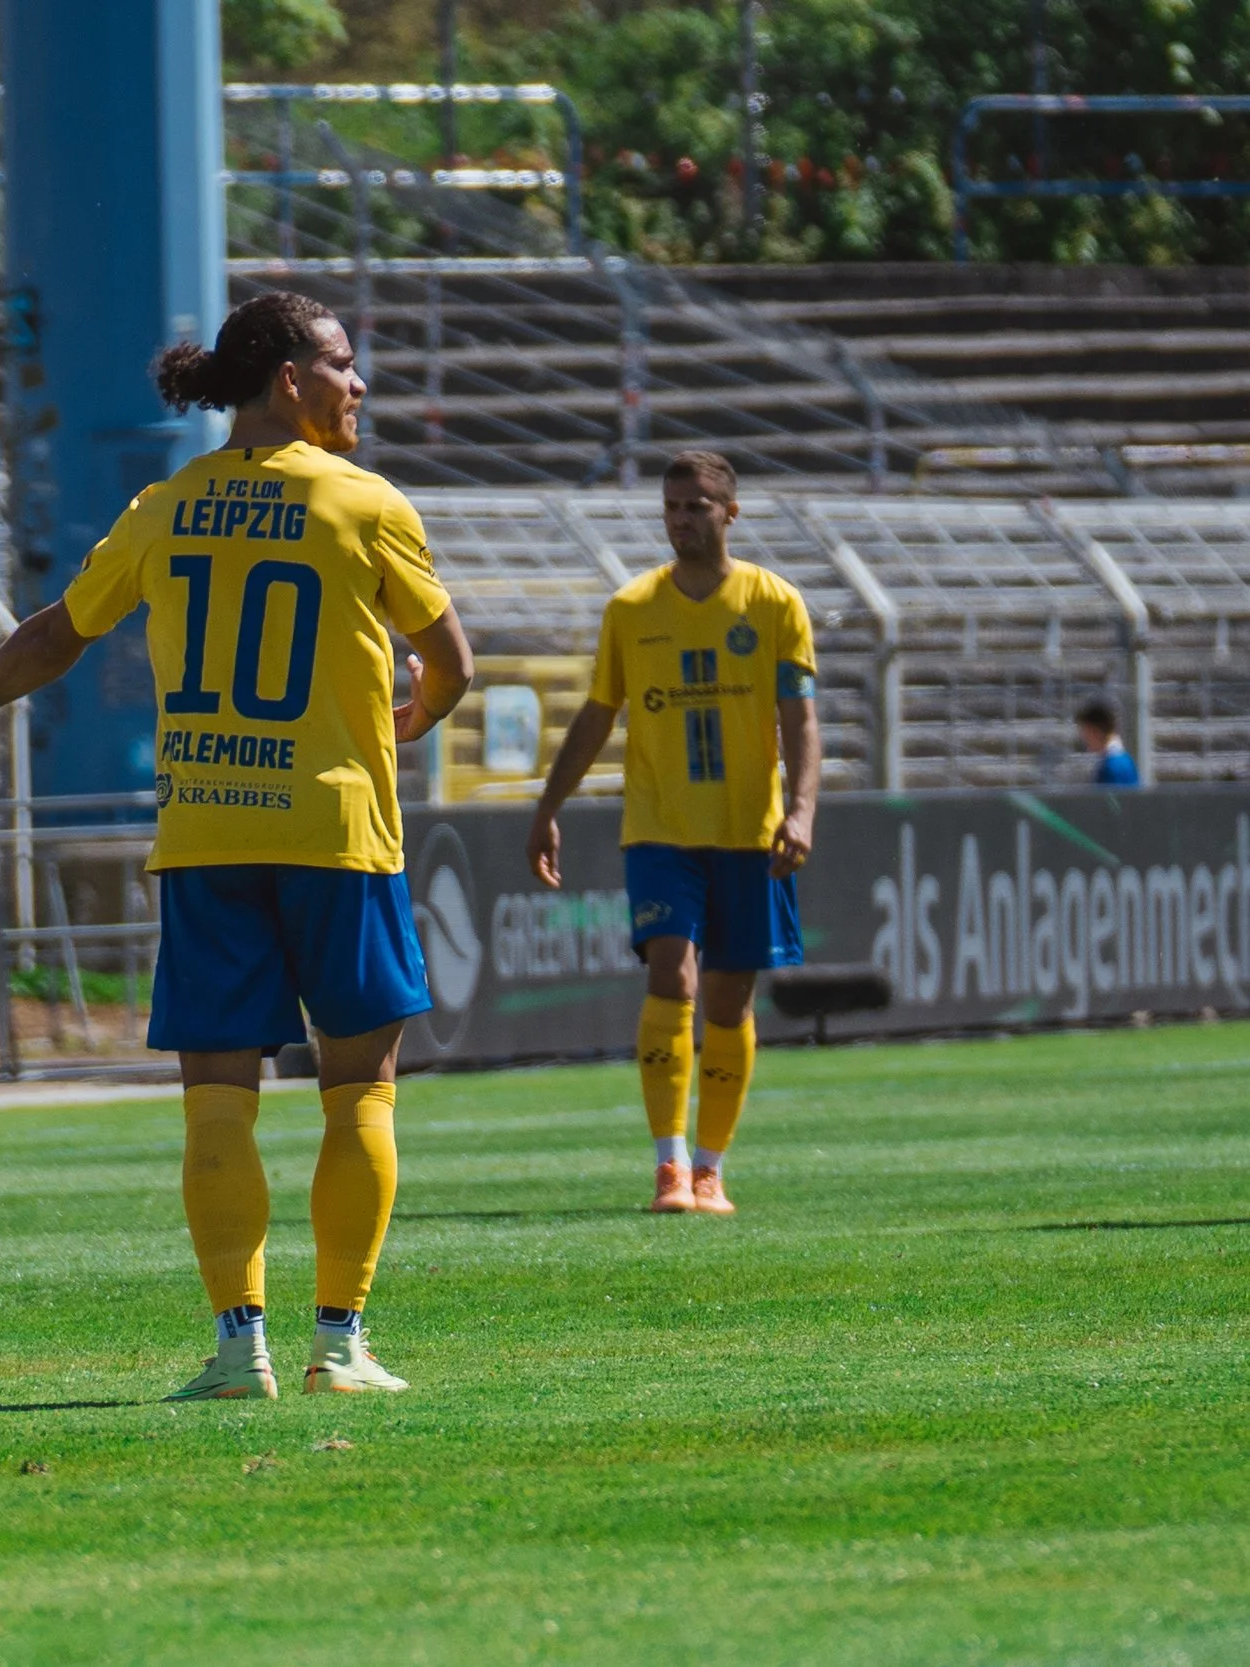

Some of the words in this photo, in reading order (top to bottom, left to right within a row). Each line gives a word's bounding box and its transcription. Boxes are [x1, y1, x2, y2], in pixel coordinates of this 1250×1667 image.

[206, 478, 222, 497] 1.
[225, 479, 249, 498] FC
[251, 480, 286, 499] LOK
[172, 498, 307, 541] LEIPZIG
[164, 554, 322, 722] 10
[177, 786, 293, 810] KRABBES
[871, 822, 942, 1001] als
